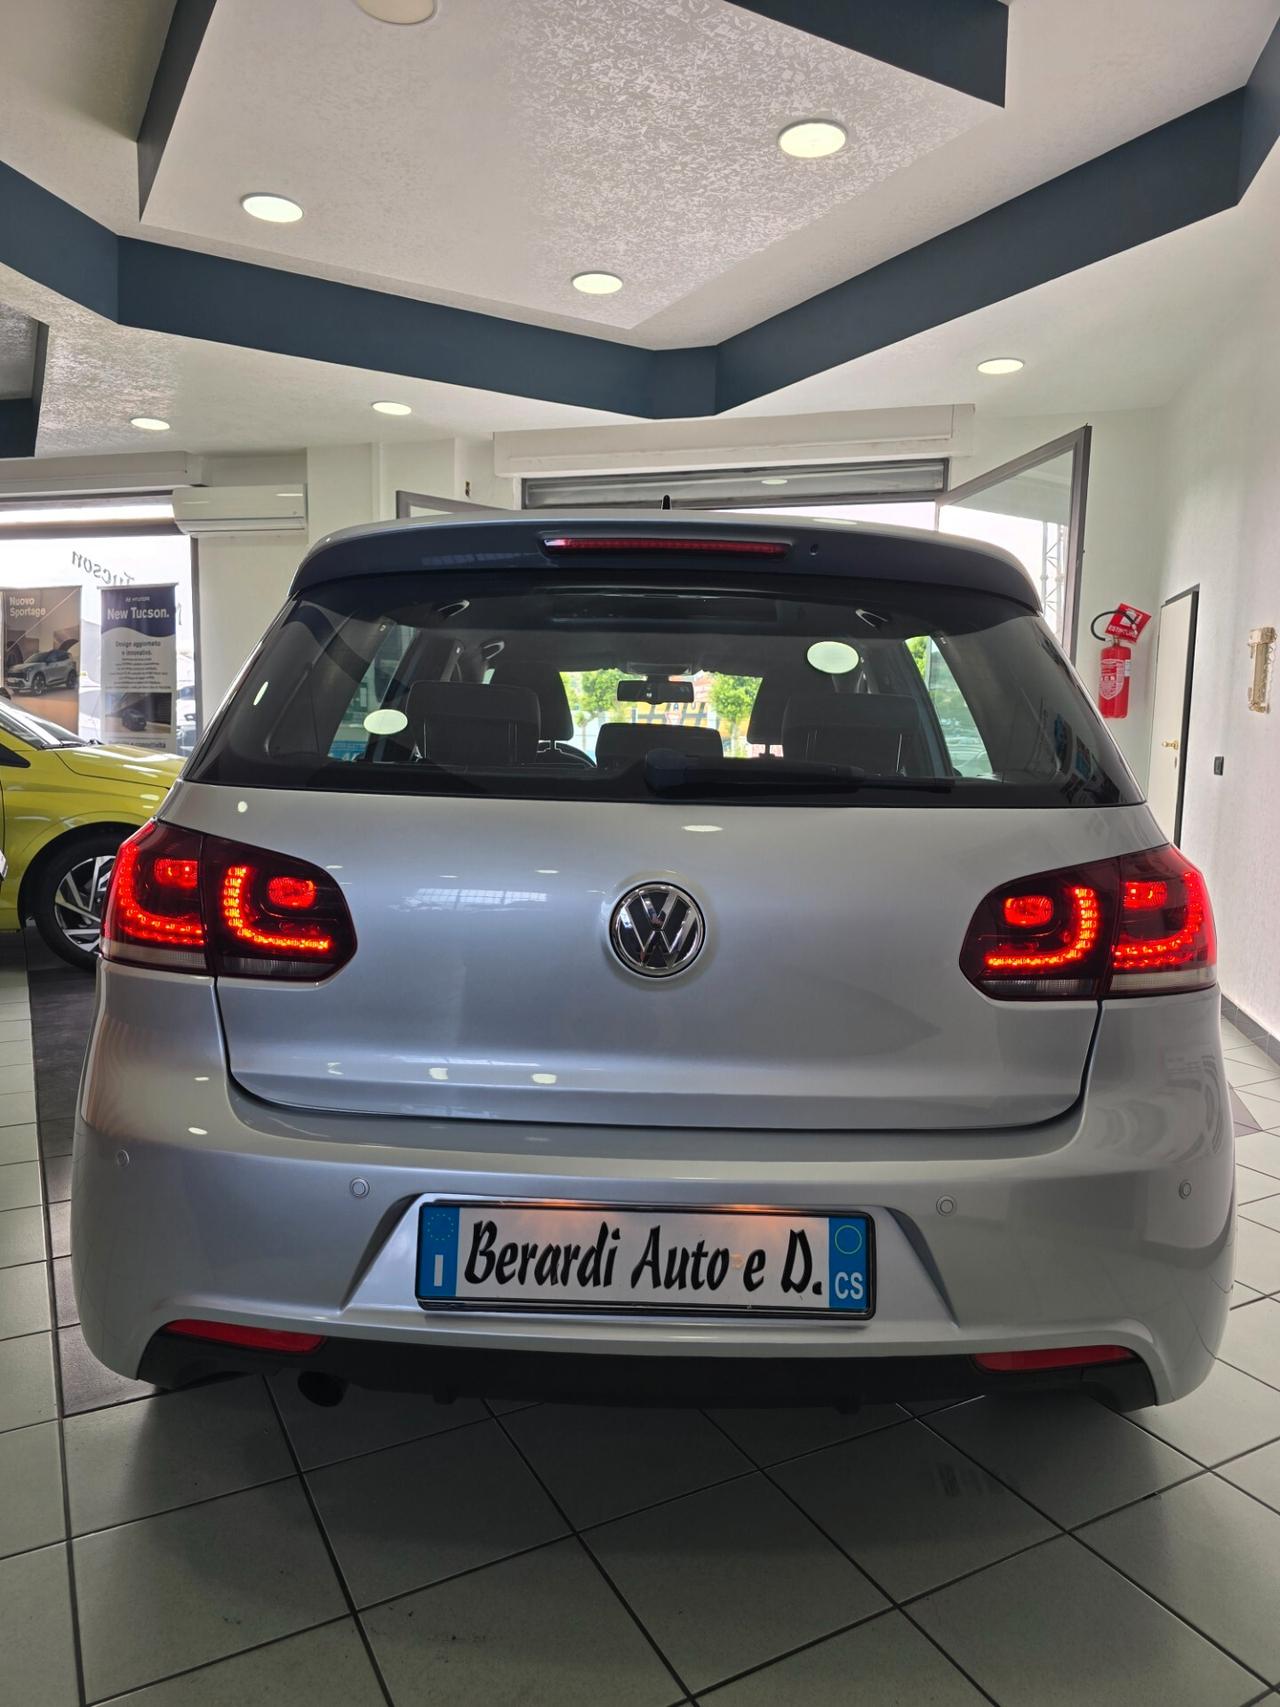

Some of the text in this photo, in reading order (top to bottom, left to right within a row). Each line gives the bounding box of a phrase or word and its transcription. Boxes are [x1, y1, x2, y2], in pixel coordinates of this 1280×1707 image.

[9, 596, 35, 606] Nuovo
[10, 607, 46, 618] Sportage
[107, 608, 128, 620] New
[131, 607, 170, 619] Tucson.
[464, 1220, 823, 1296] Berardi Auto e D.
[433, 1254, 443, 1288] I
[835, 1272, 864, 1300] CS
